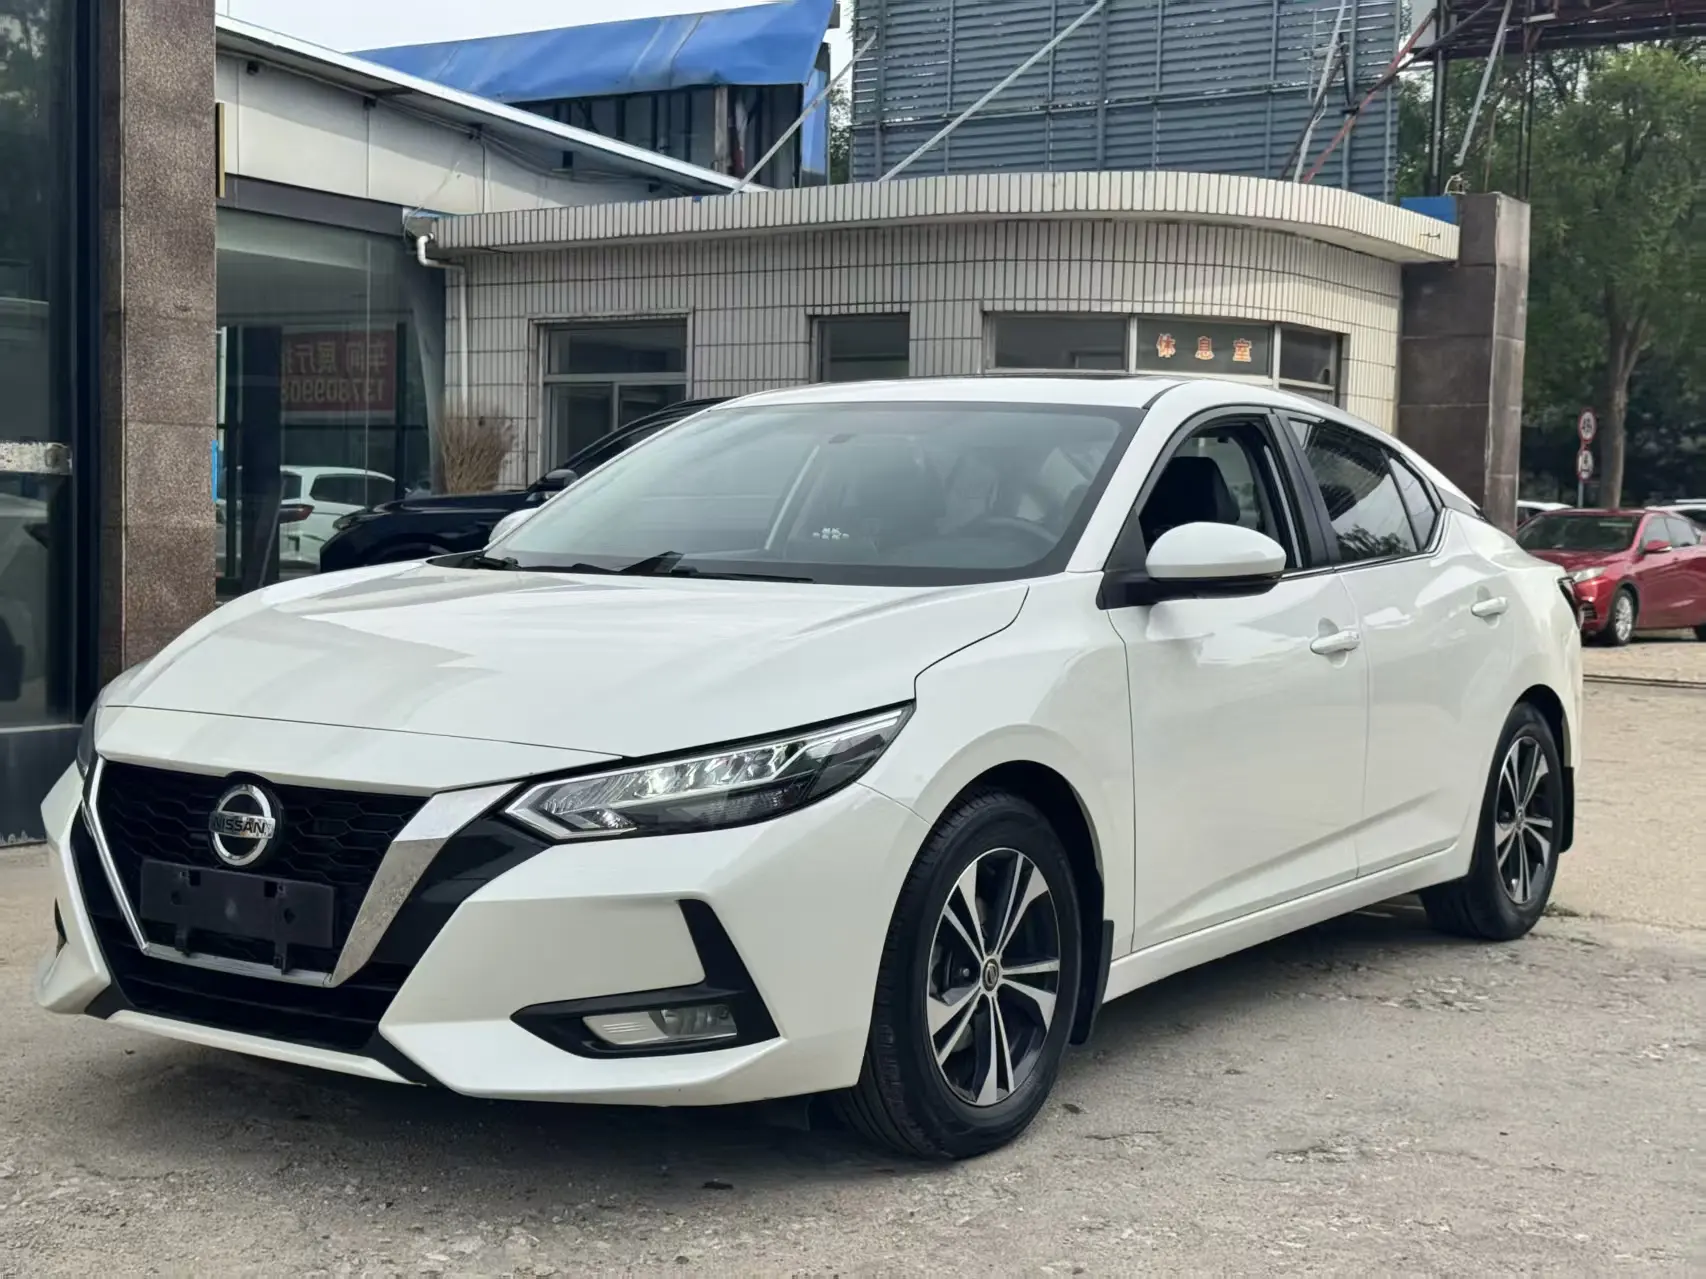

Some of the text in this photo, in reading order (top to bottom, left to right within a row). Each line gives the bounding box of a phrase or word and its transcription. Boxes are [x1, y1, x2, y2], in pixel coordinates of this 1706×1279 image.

[1156, 333, 1252, 362] 休息室
[213, 815, 266, 834] NISSAN
